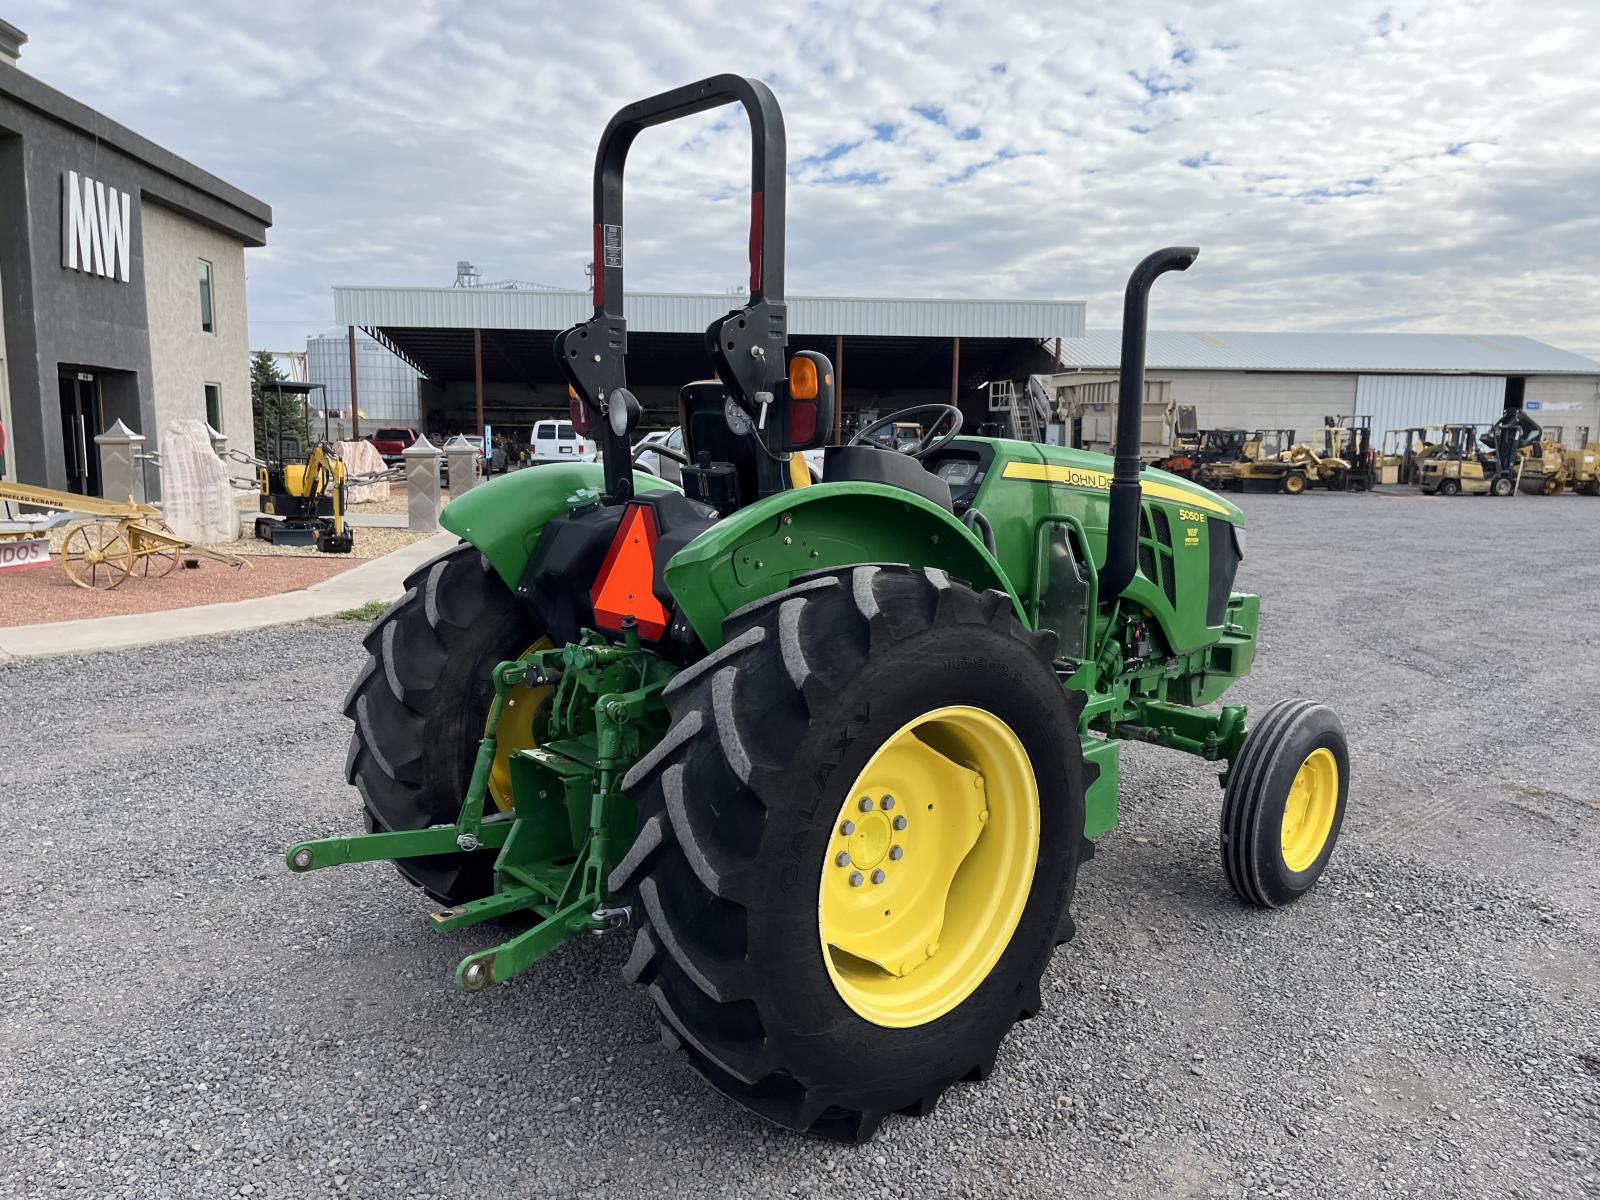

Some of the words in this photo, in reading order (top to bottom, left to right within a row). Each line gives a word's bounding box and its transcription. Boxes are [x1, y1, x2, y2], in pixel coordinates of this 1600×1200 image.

[64, 170, 130, 282] MW
[1064, 470, 1096, 486] JOHN
[31, 498, 63, 507] SCRAPER
[1179, 509, 1205, 523] 5050E
[0, 543, 40, 563] DOS
[780, 702, 871, 894] GALAXY
